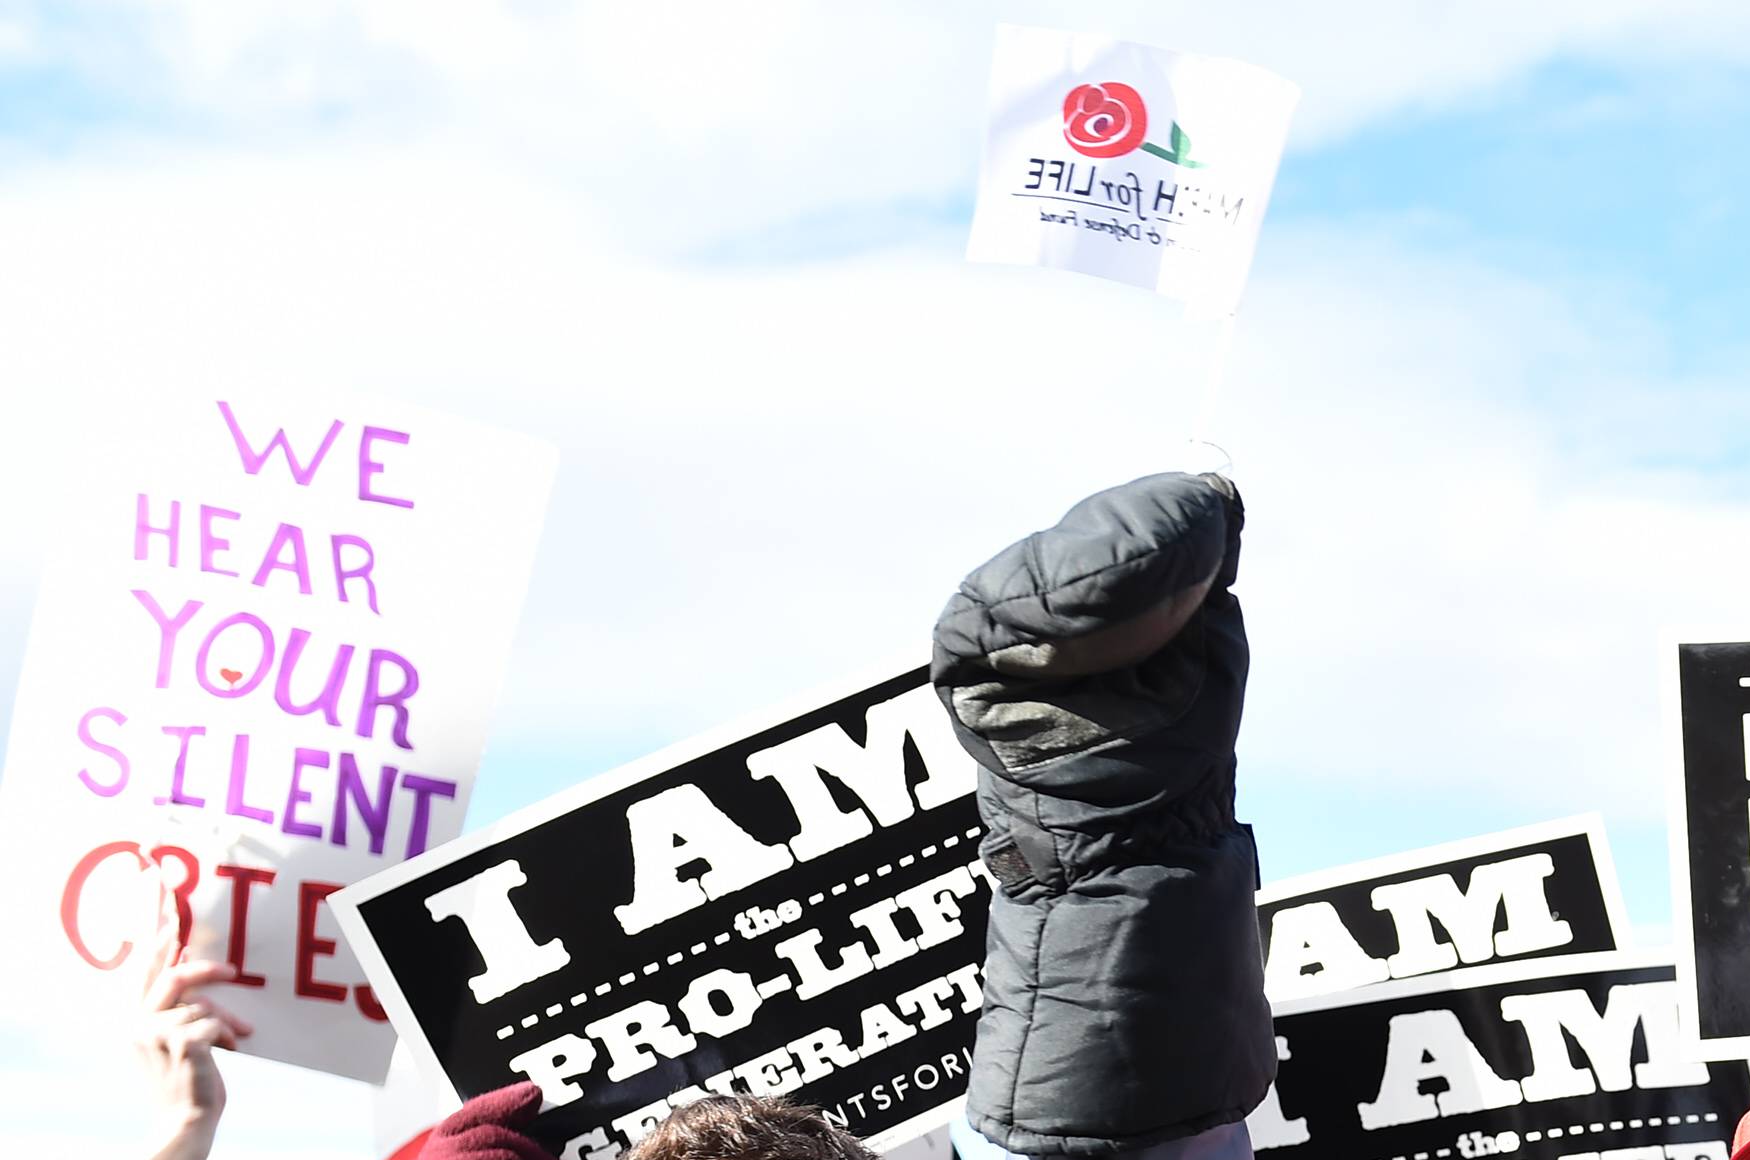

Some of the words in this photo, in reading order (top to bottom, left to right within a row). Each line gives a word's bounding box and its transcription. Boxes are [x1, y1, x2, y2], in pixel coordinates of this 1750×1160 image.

[216, 400, 415, 509] WE
[133, 492, 381, 616] HEAR
[129, 588, 421, 751] YOUR
[76, 706, 458, 861] SILENT
[424, 858, 571, 1004] I
[613, 682, 979, 936] AM
[60, 839, 390, 1023] CRIE
[733, 898, 803, 940] the
[1263, 852, 1574, 995] AM
[1357, 980, 1711, 1132] AM
[1455, 1130, 1521, 1160] the
